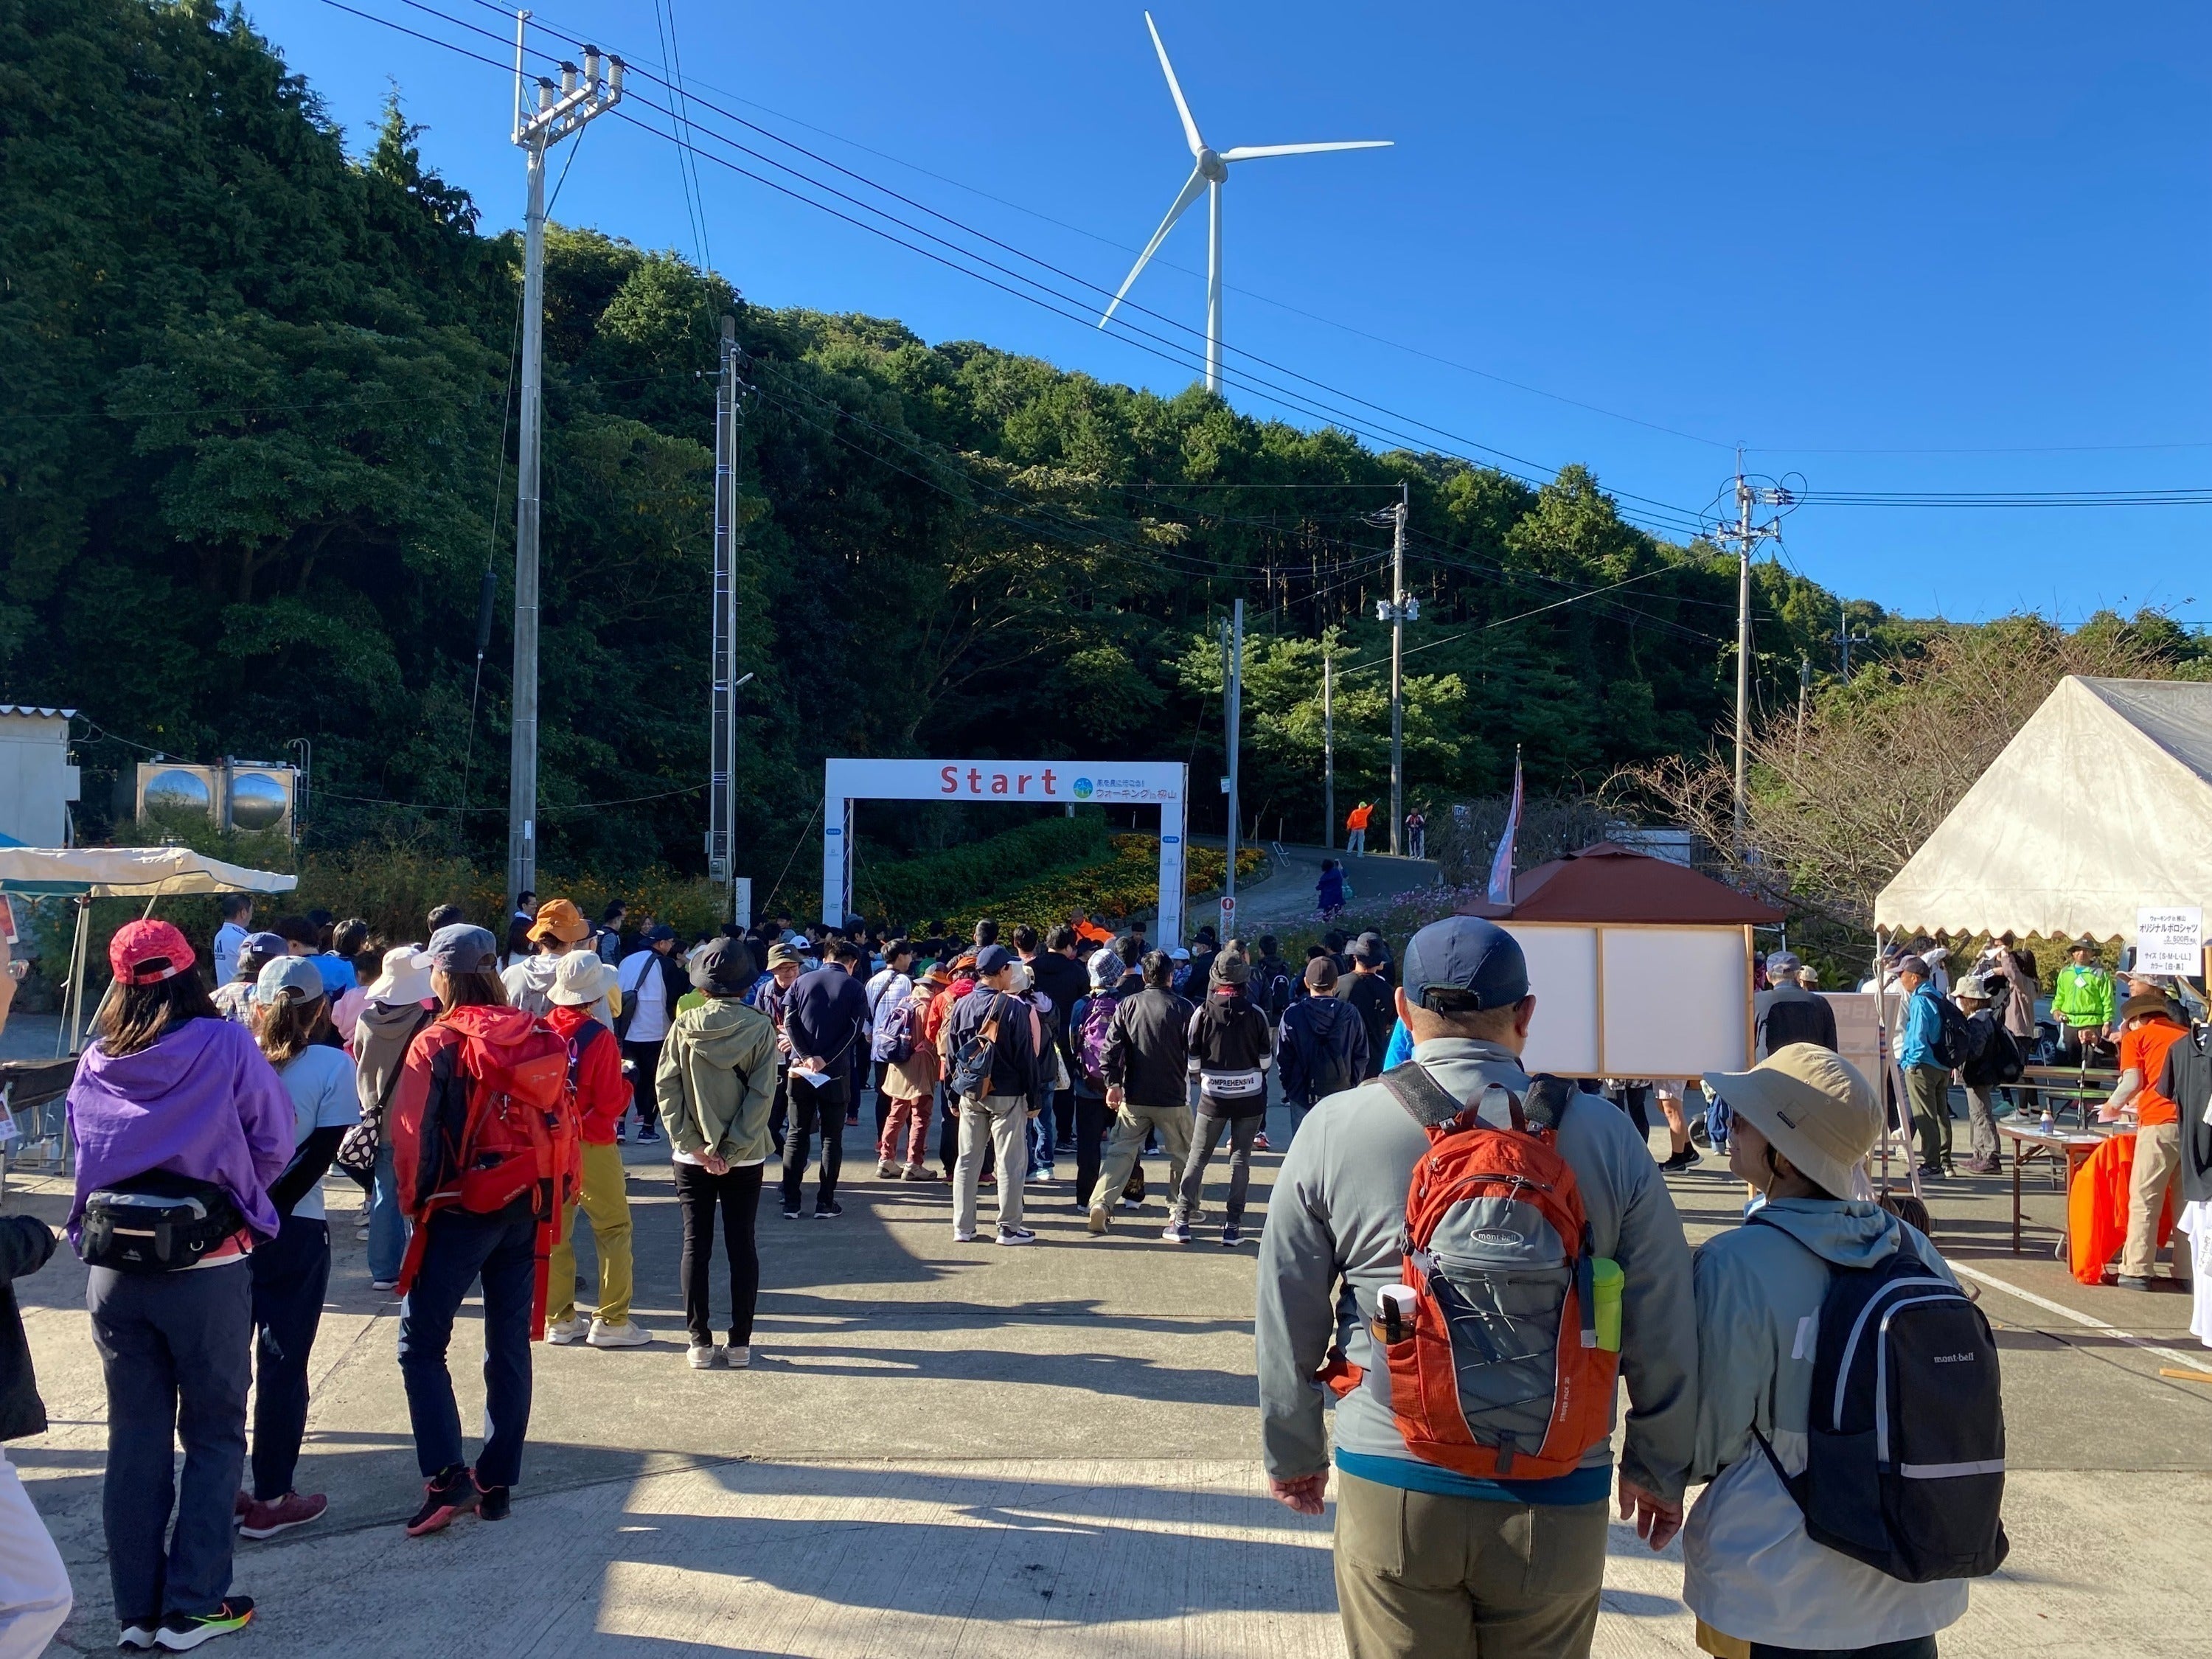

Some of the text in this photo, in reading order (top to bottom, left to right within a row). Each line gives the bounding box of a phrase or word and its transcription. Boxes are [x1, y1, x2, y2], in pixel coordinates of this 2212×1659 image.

[941, 766, 1057, 795] Start
[2139, 923, 2198, 933] オリジナルポロシャツ
